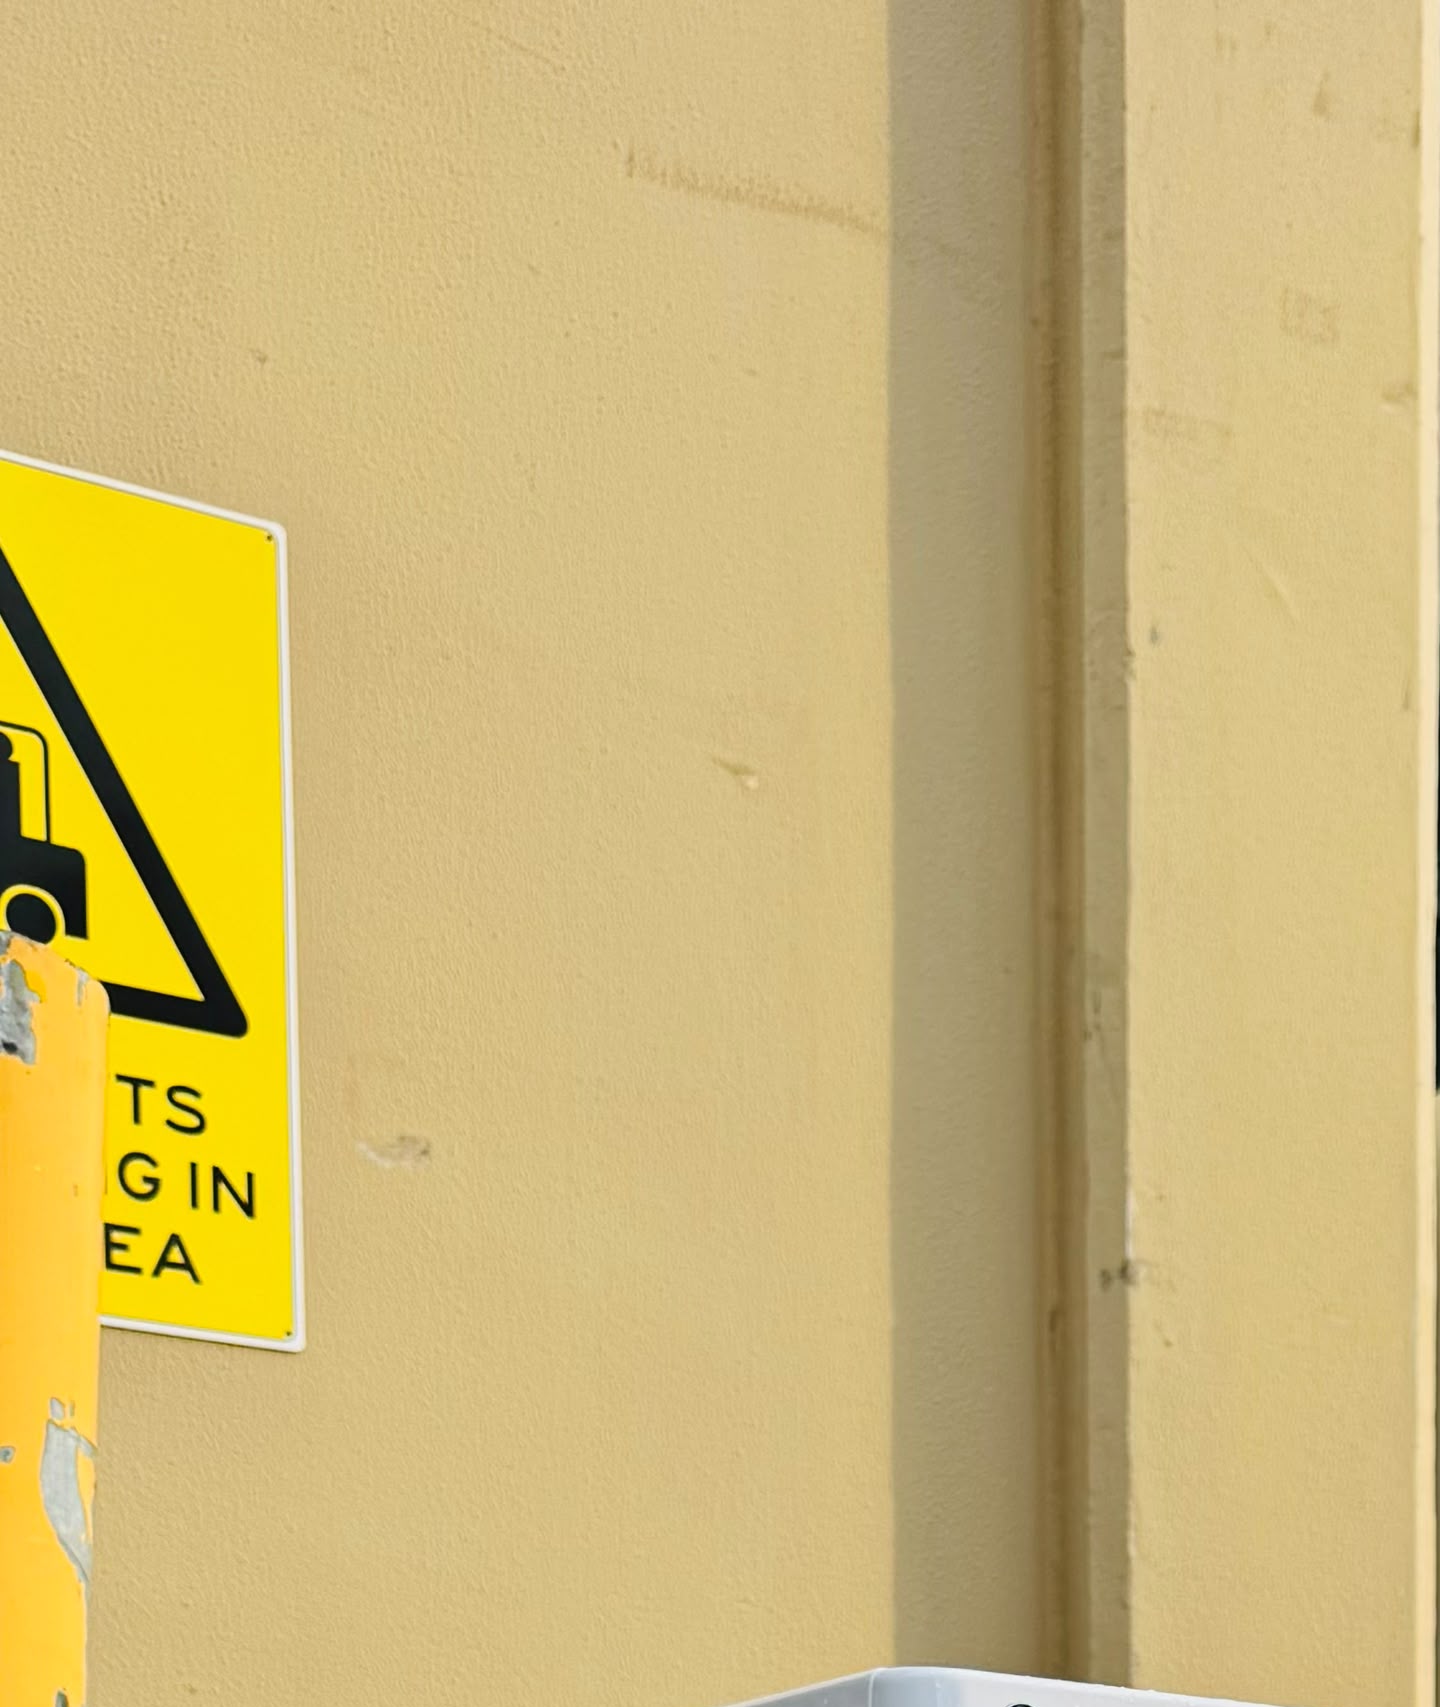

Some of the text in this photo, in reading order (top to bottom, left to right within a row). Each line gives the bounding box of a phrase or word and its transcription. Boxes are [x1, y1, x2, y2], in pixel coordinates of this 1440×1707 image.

[114, 1073, 207, 1136] TS
[116, 1150, 256, 1220] G IN
[103, 1221, 203, 1286] EA
